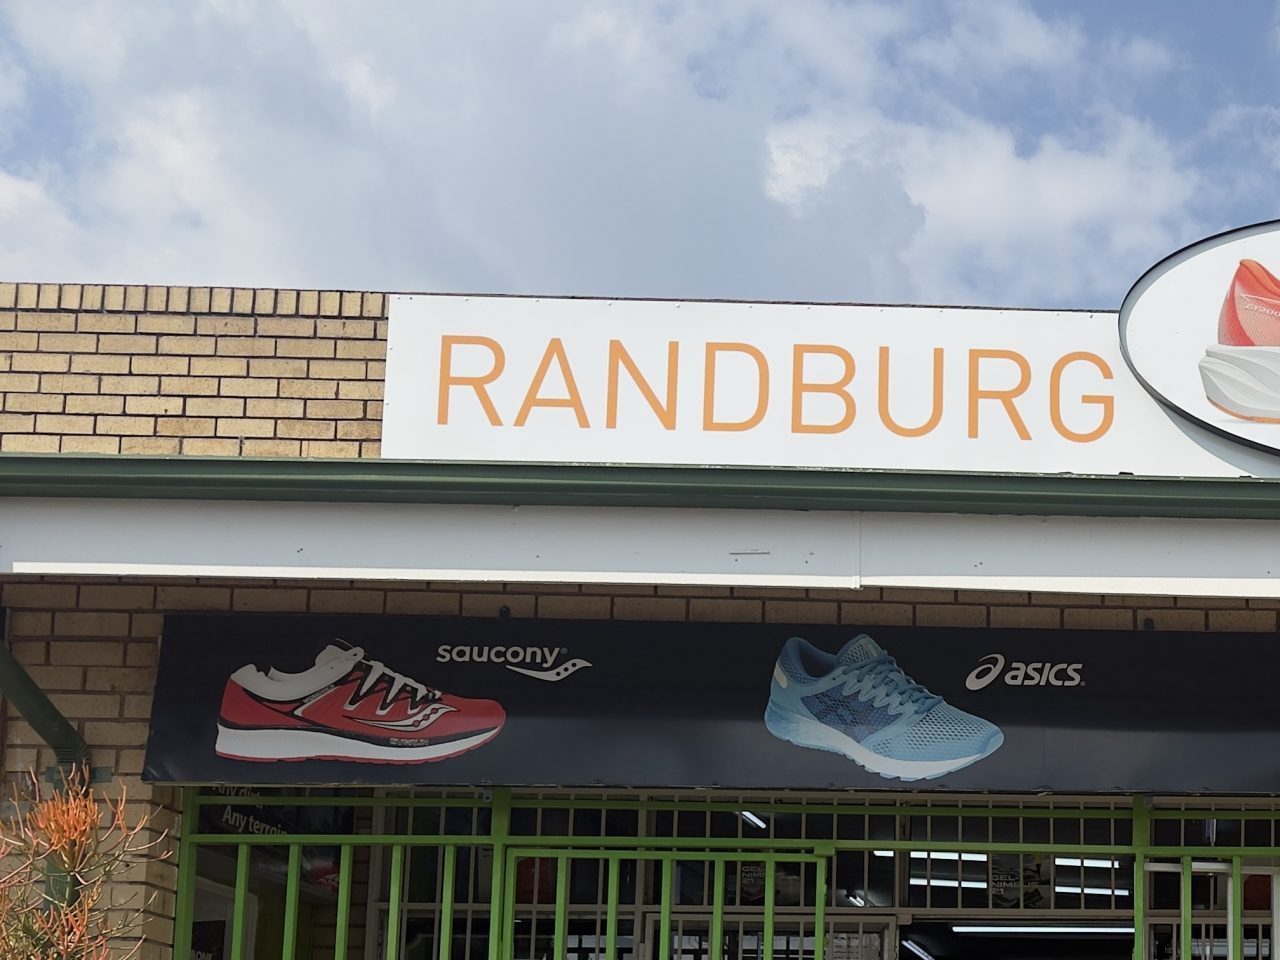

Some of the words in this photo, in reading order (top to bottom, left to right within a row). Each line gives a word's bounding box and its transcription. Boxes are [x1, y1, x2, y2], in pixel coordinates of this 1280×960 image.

[436, 334, 1115, 443] RANDBURG
[435, 643, 560, 665] saucony
[222, 804, 247, 833] Any
